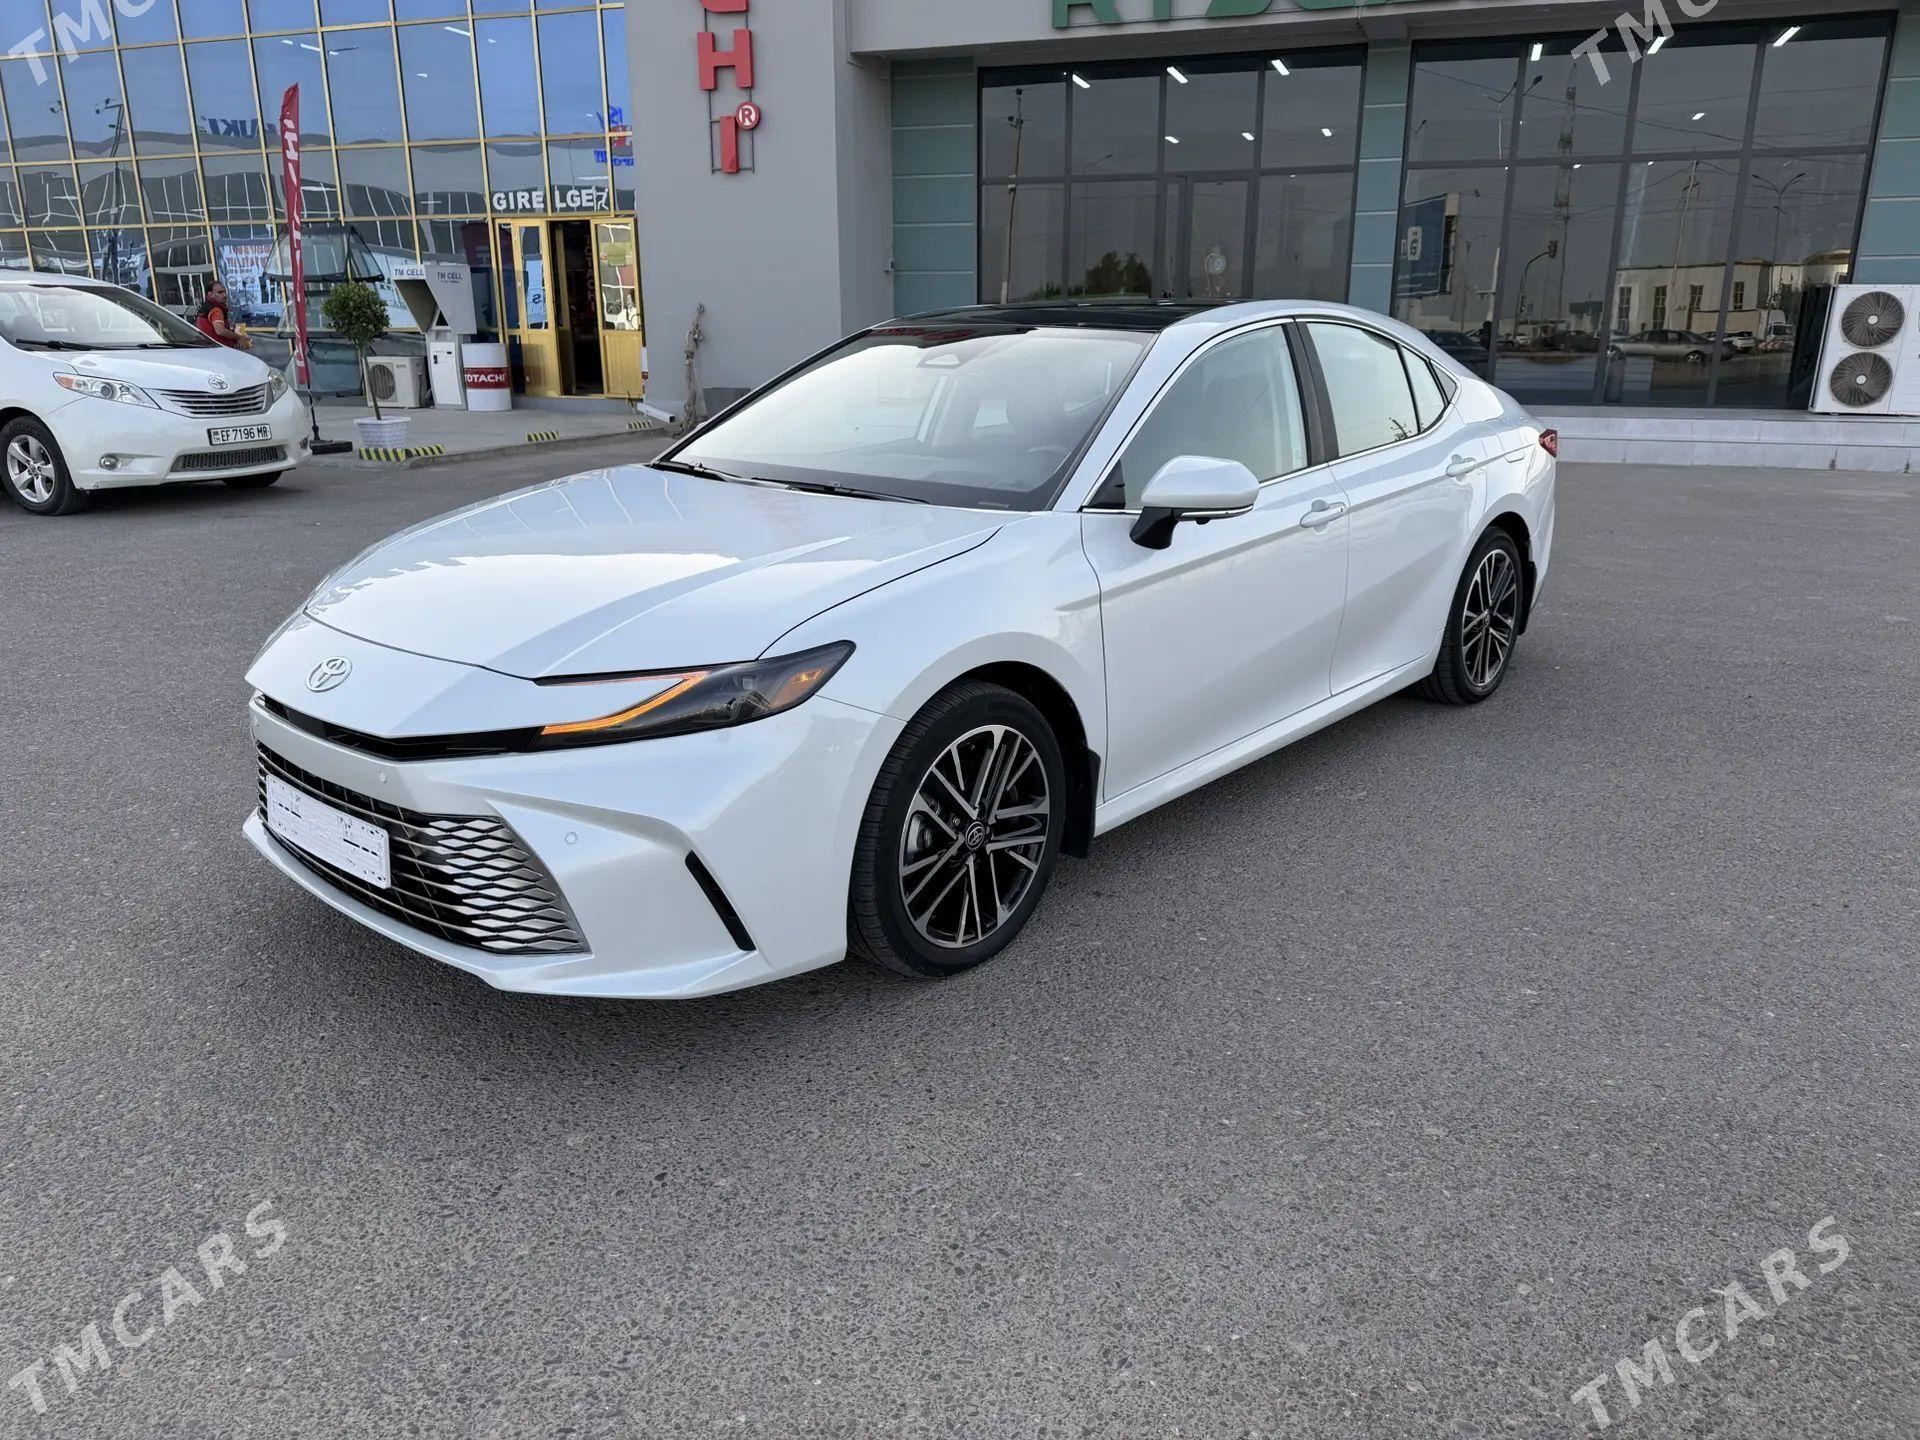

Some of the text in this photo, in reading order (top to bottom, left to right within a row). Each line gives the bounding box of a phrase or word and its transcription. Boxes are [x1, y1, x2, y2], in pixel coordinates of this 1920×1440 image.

[447, 272, 463, 280] CELL
[220, 429, 230, 441] EF
[232, 427, 255, 440] 7196
